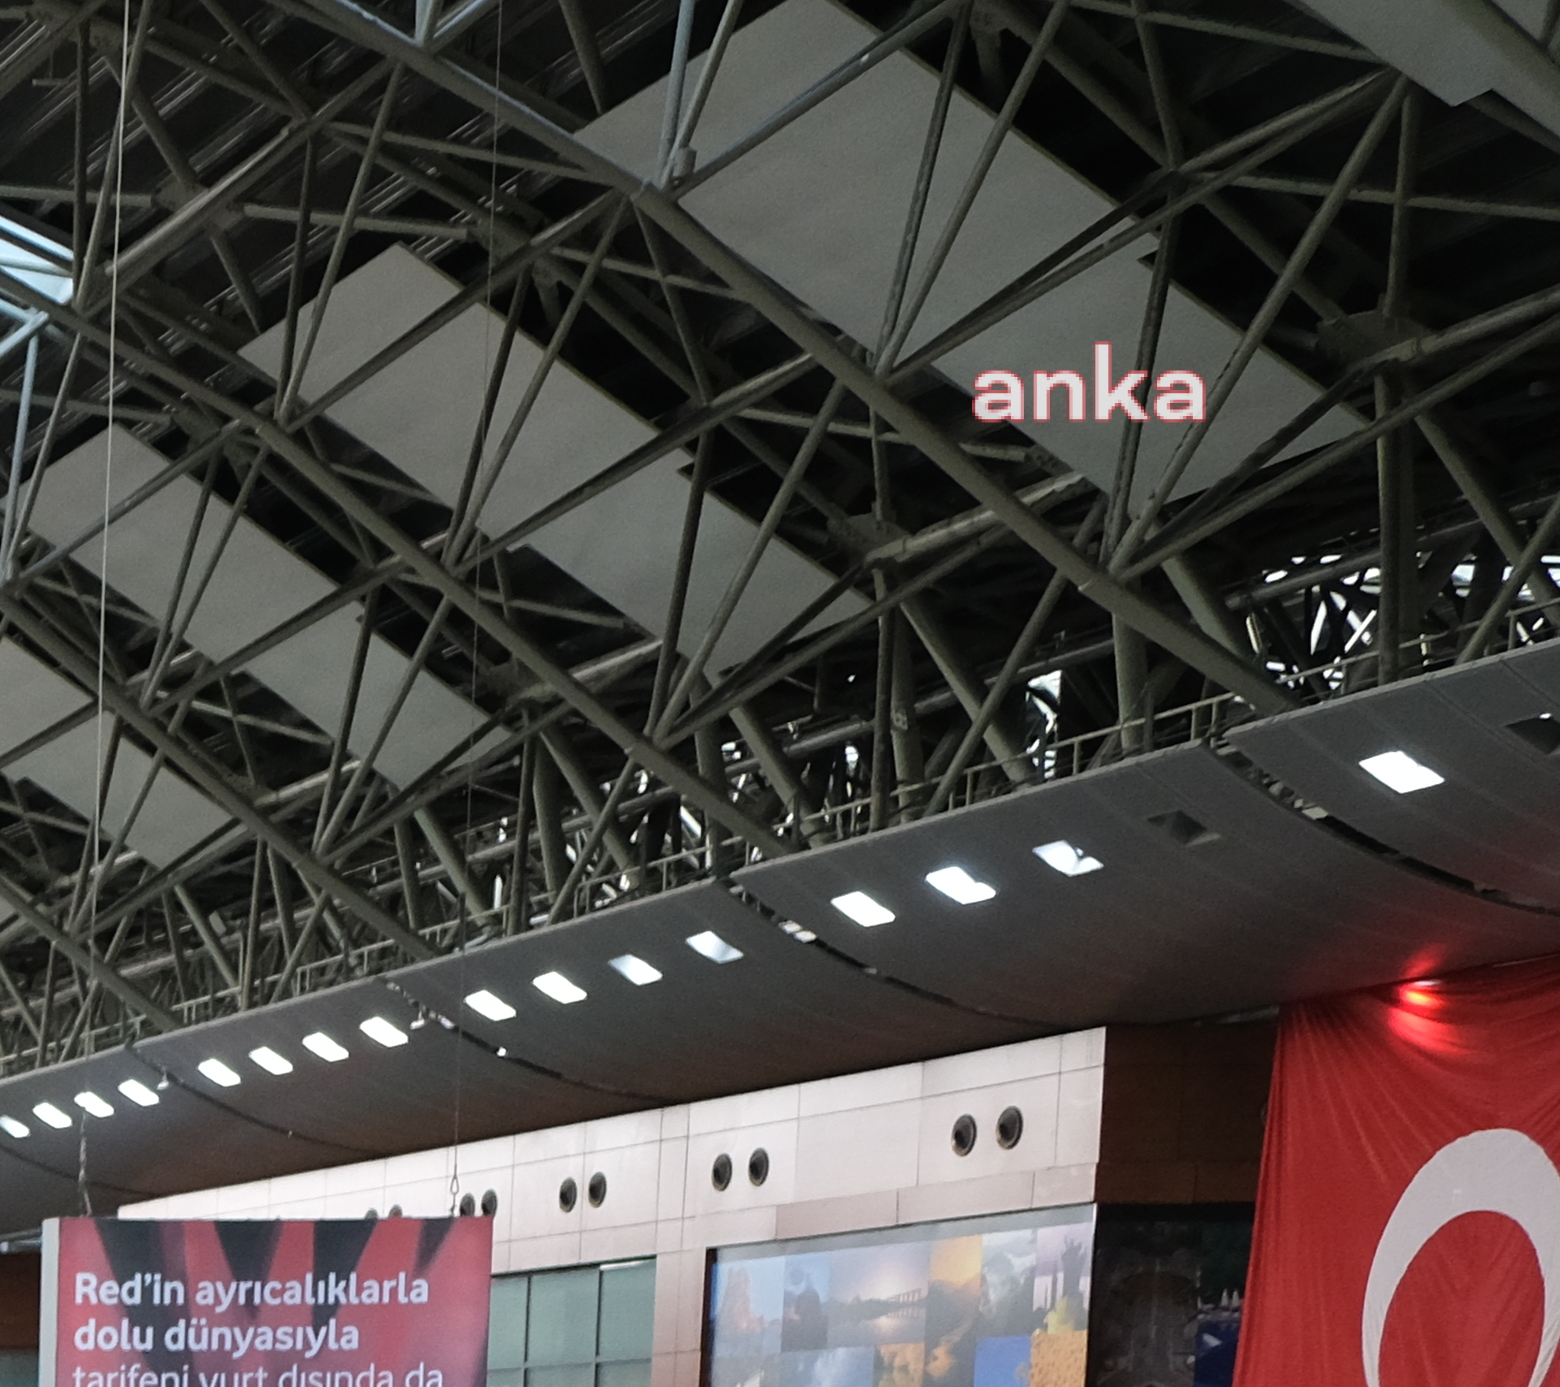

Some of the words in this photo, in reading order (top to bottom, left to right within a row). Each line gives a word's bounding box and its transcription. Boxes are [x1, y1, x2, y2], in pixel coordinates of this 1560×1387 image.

[196, 1271, 429, 1313] ayrıcalıklarla
[74, 1317, 153, 1352] dolu
[165, 1319, 359, 1359] dünyasıyla
